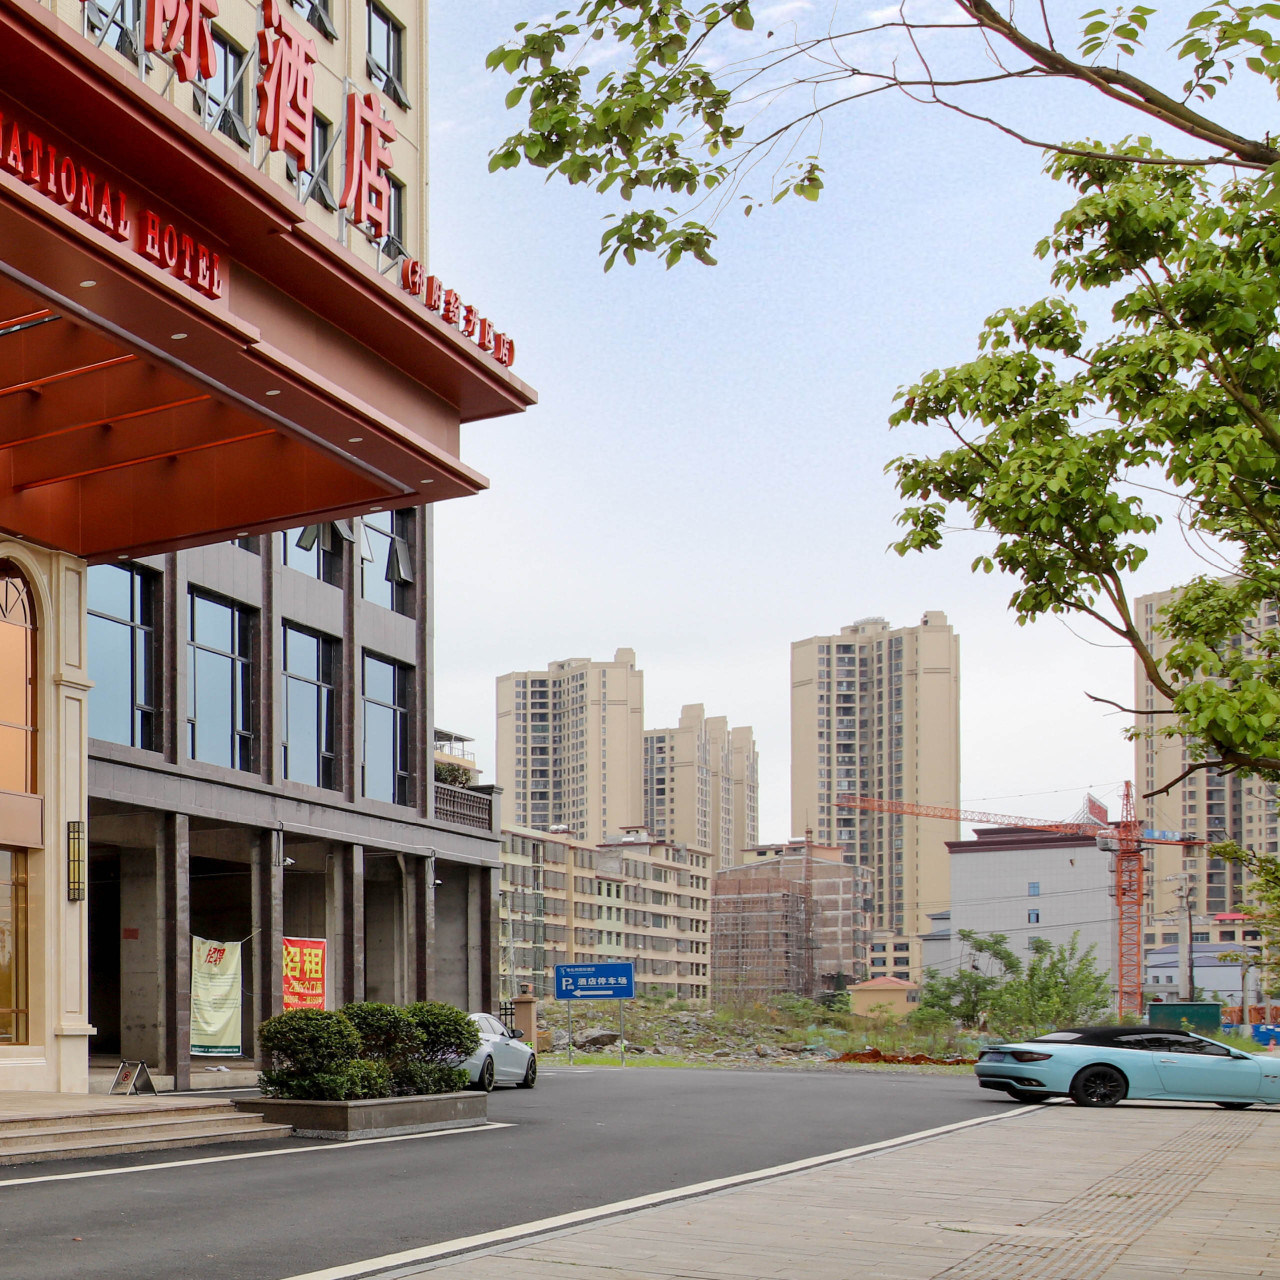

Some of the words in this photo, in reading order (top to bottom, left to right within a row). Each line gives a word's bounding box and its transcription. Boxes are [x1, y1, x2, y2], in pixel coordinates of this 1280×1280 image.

[144, 210, 223, 298] HOTEL
[578, 976, 628, 986] 酒店停车场
